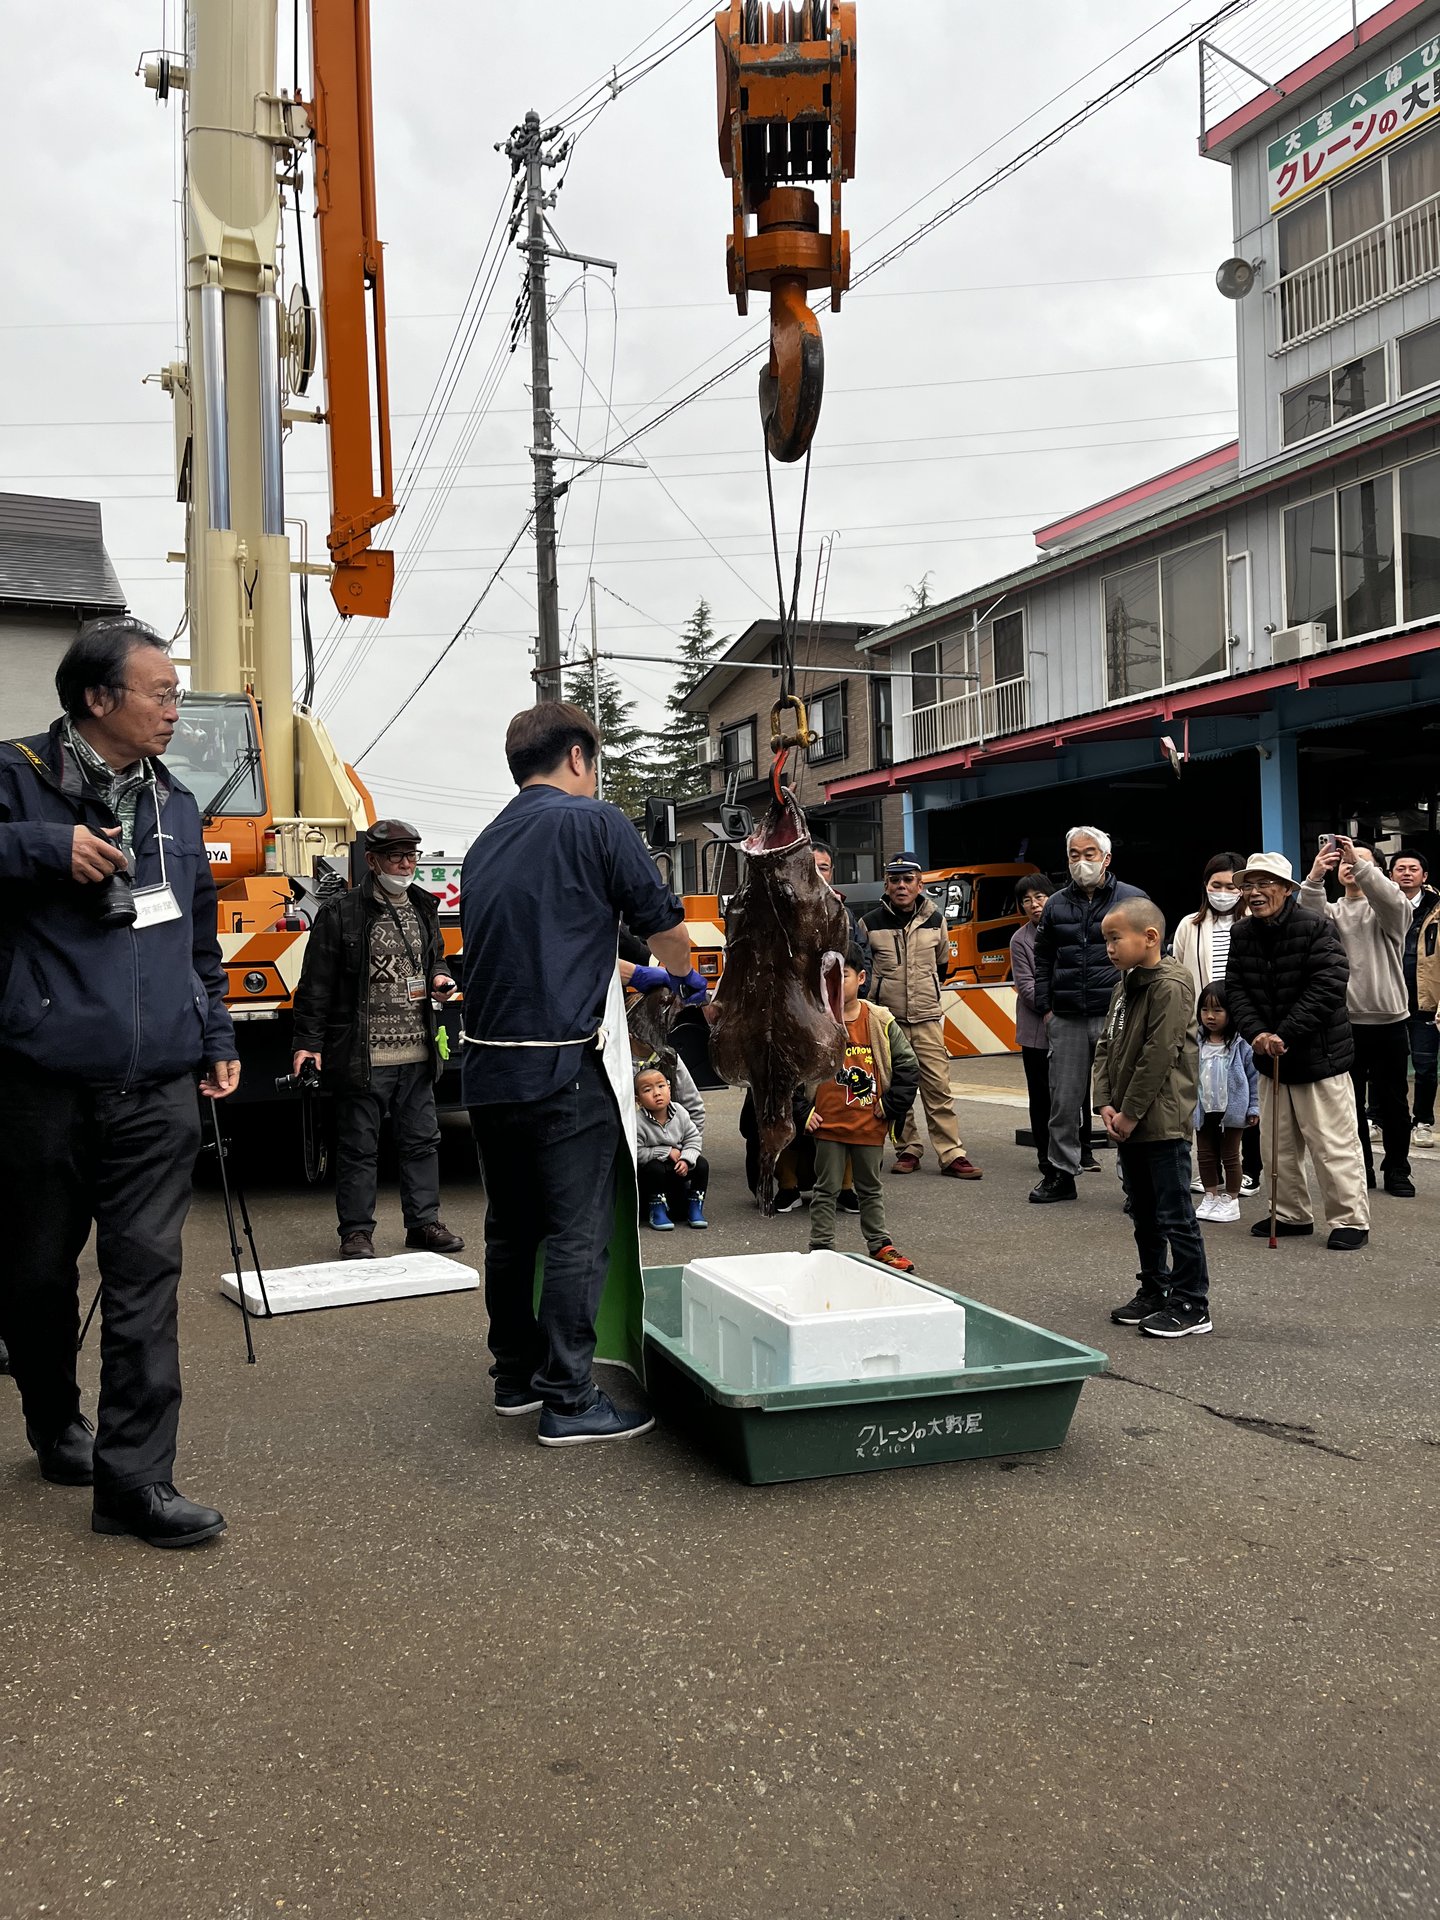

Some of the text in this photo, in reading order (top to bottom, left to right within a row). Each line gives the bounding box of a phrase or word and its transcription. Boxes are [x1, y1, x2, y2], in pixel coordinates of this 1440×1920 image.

[857, 1412, 984, 1446] クレーンの大野屋
